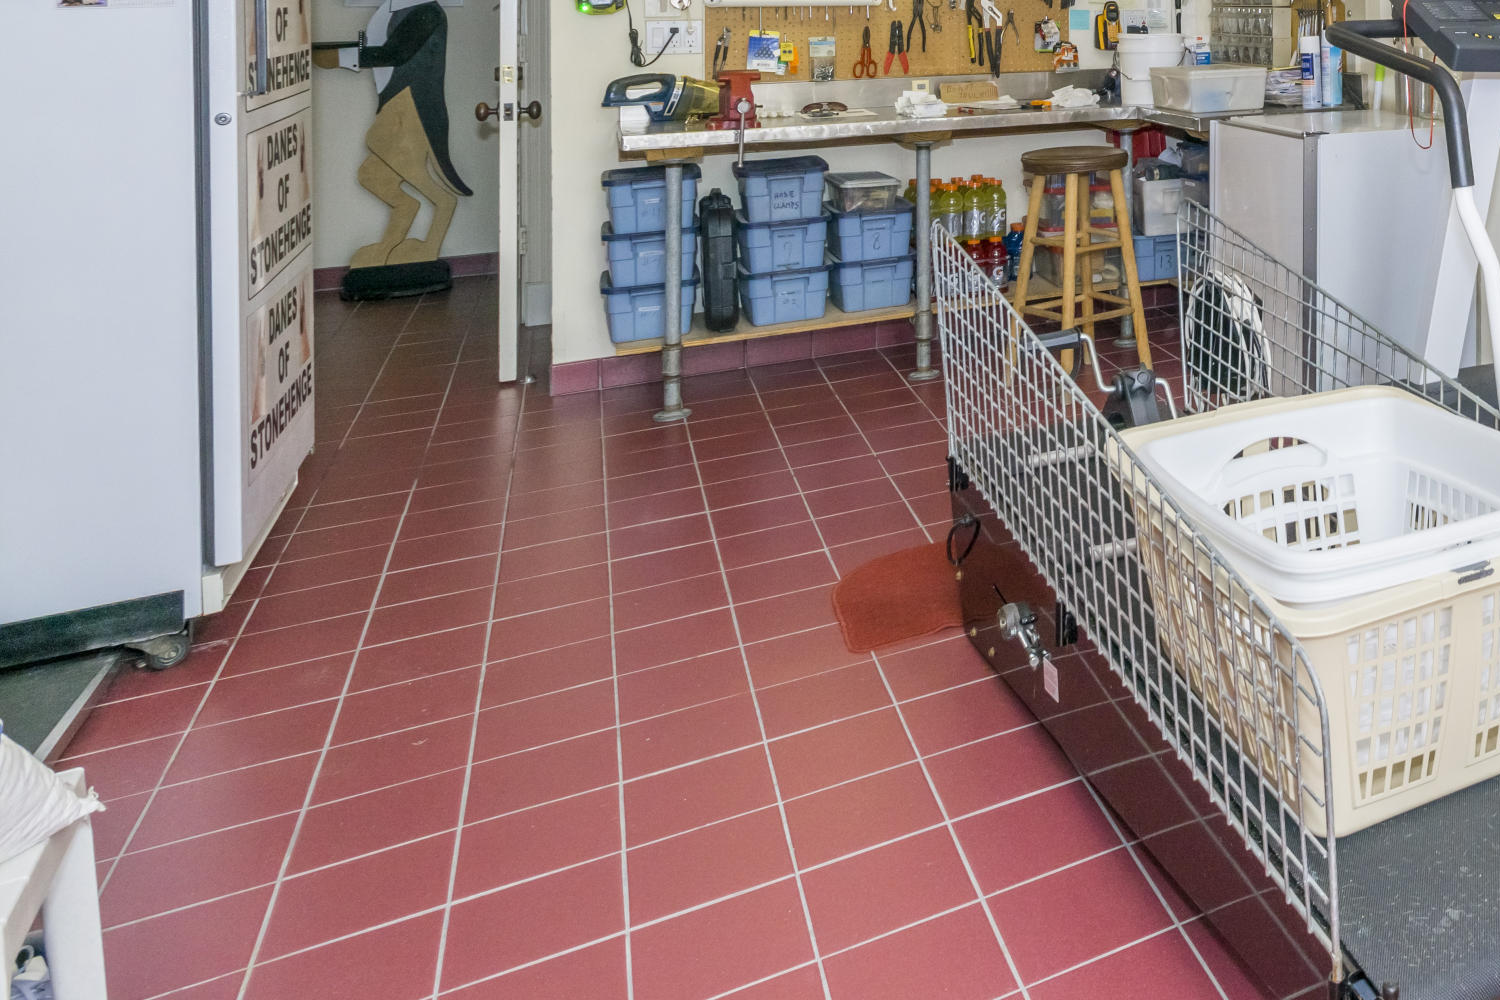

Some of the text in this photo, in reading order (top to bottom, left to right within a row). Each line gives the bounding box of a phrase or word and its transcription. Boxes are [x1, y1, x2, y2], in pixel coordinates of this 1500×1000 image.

[275, 7, 289, 42] OF
[248, 49, 310, 98] SNEHENGE
[267, 123, 298, 171] DANES
[277, 173, 290, 213] OF
[250, 203, 311, 285] STONEHENGE
[872, 232, 881, 250] 8
[1160, 254, 1172, 269] 13
[993, 266, 1003, 278] G
[268, 286, 297, 345] DANES
[278, 340, 290, 384] OF
[250, 363, 312, 469] STONEHENGE
